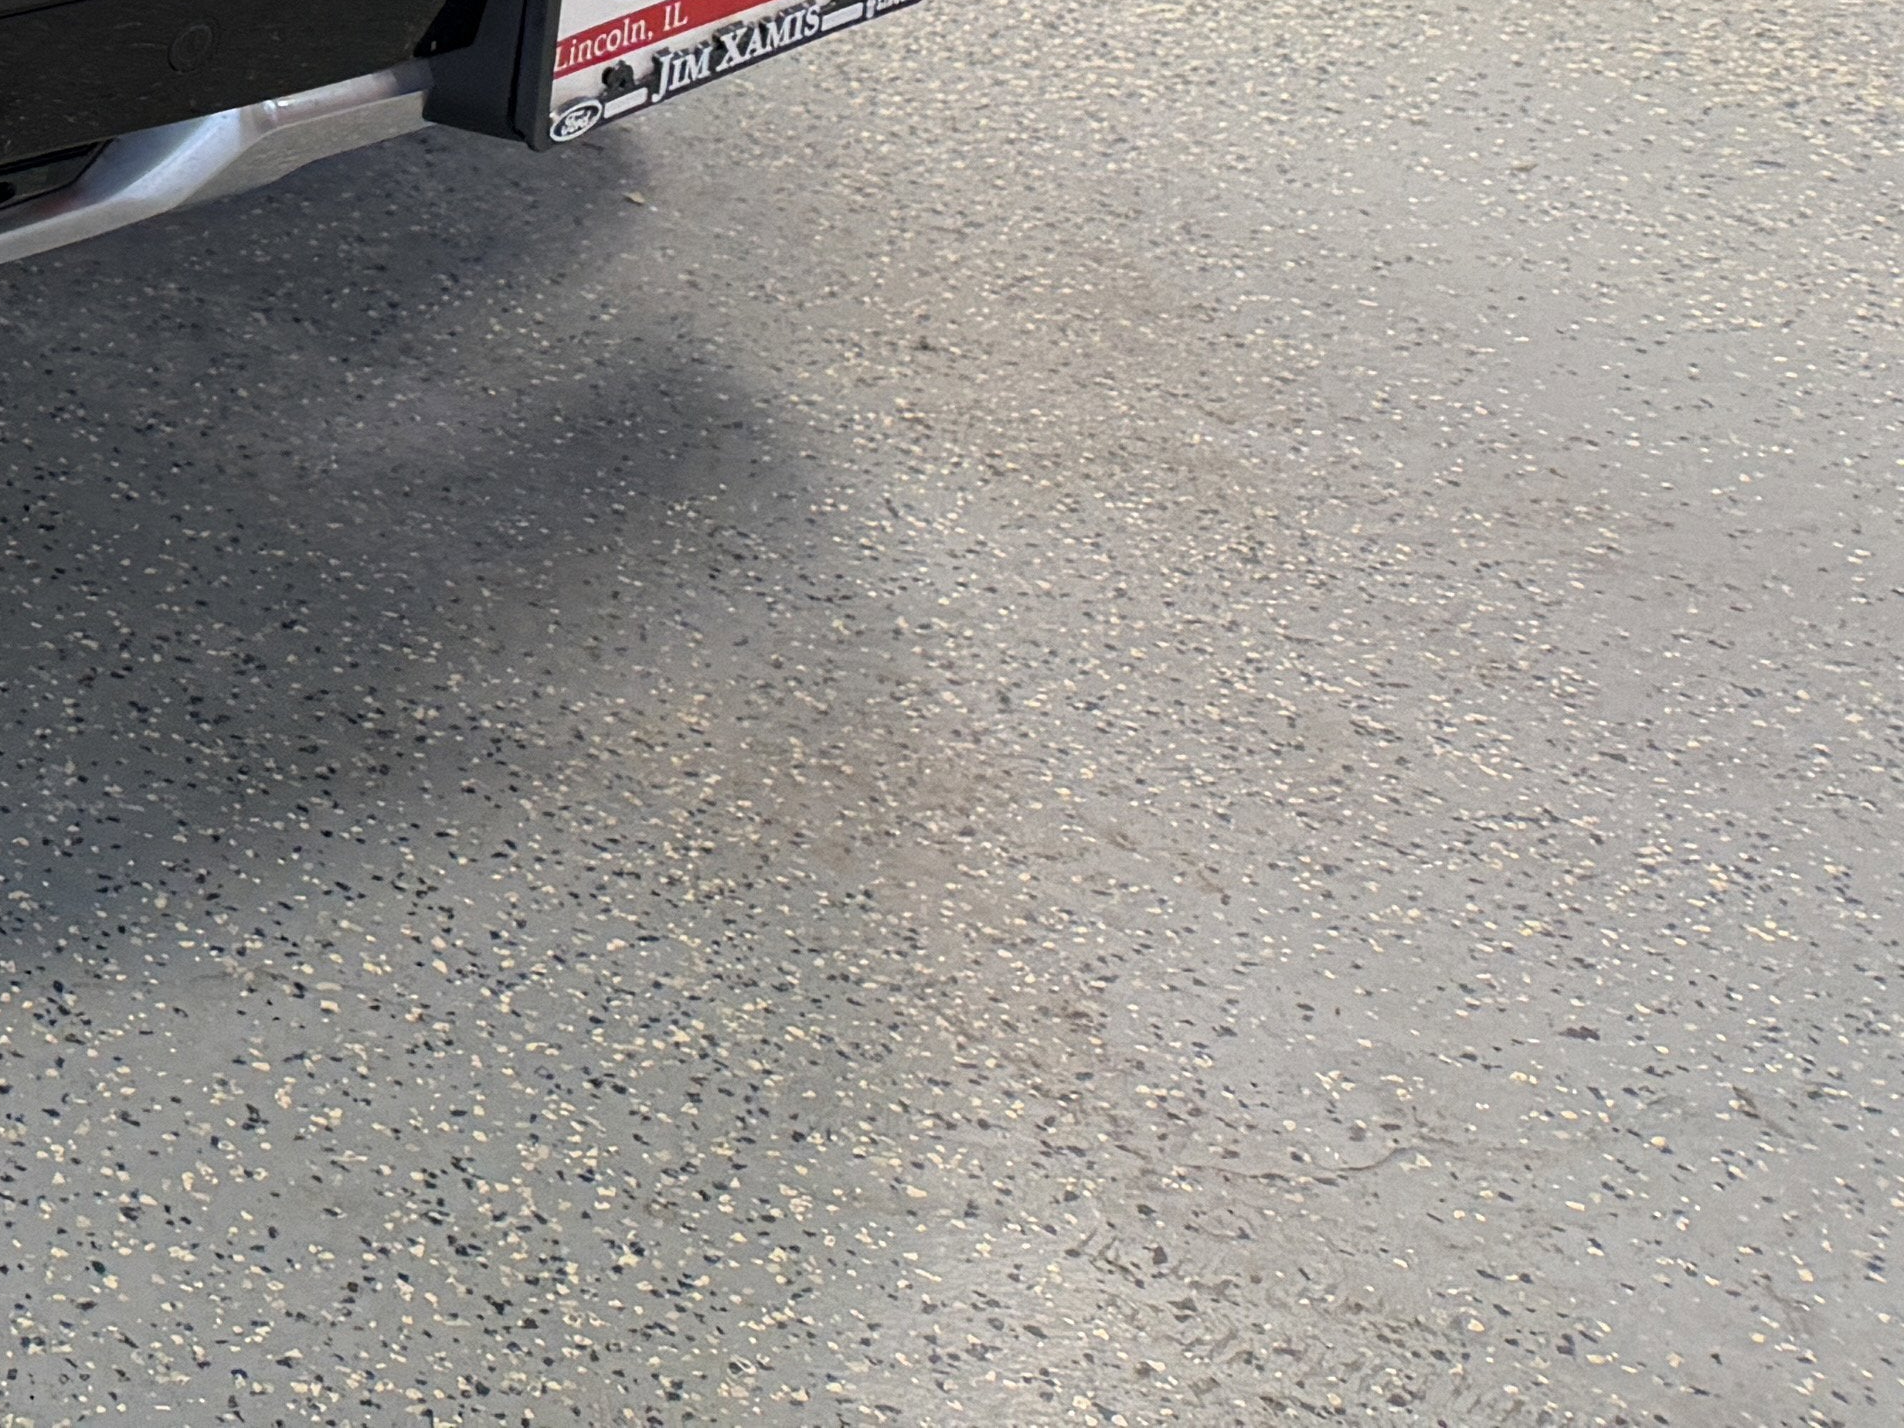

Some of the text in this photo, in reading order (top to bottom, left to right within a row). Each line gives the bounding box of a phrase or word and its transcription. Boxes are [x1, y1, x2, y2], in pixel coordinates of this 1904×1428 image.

[554, 1, 688, 72] Lincoln, IL
[651, 4, 822, 103] JIM XAMIS
